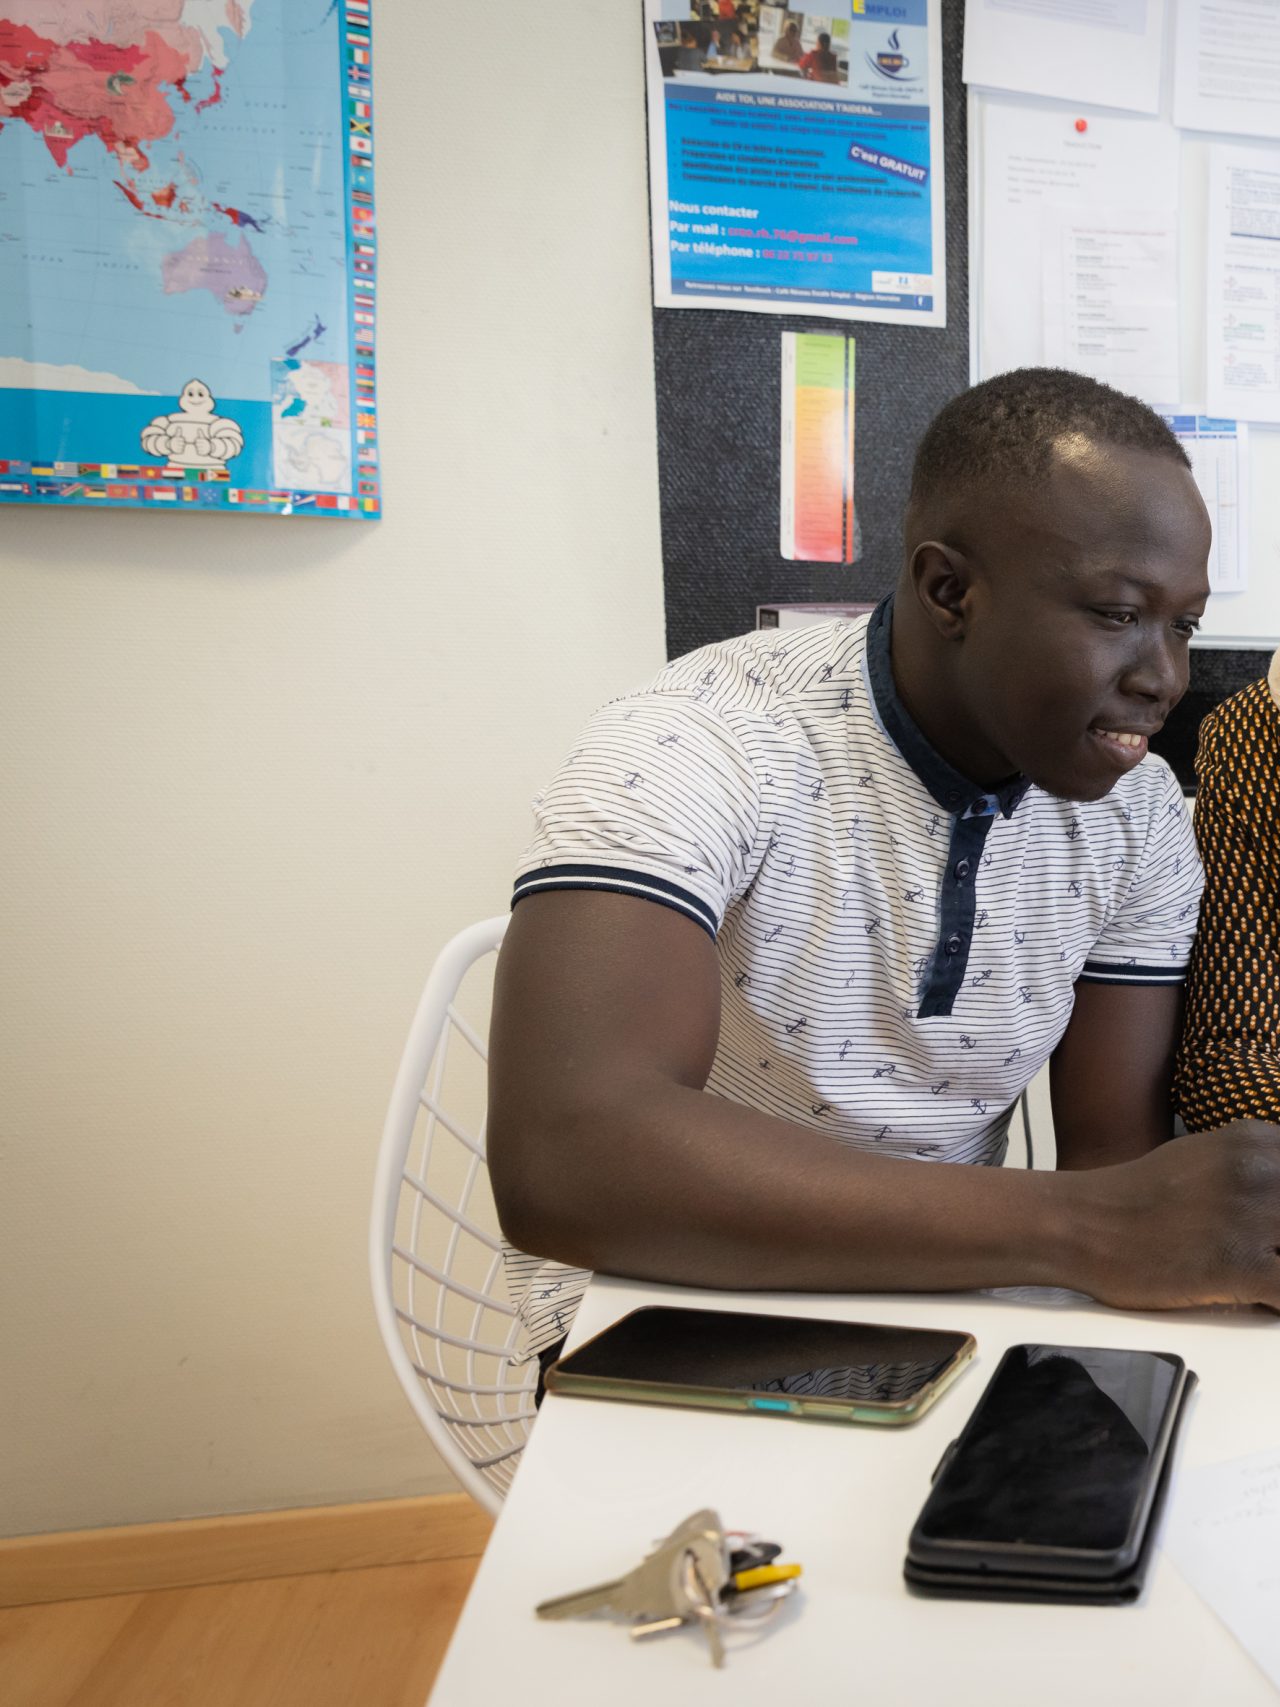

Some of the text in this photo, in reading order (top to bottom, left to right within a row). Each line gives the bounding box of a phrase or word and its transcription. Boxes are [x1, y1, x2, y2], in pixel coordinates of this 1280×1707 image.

[715, 91, 736, 103] AIDE
[757, 95, 775, 106] UNE
[777, 97, 834, 111] ASSOCIATION
[851, 145, 926, 181] C'est GRATUIT
[668, 200, 759, 219] Nous contacter
[669, 220, 690, 233] Par
[692, 222, 719, 235] mail
[670, 240, 690, 252] Par
[692, 241, 754, 258] téléphone
